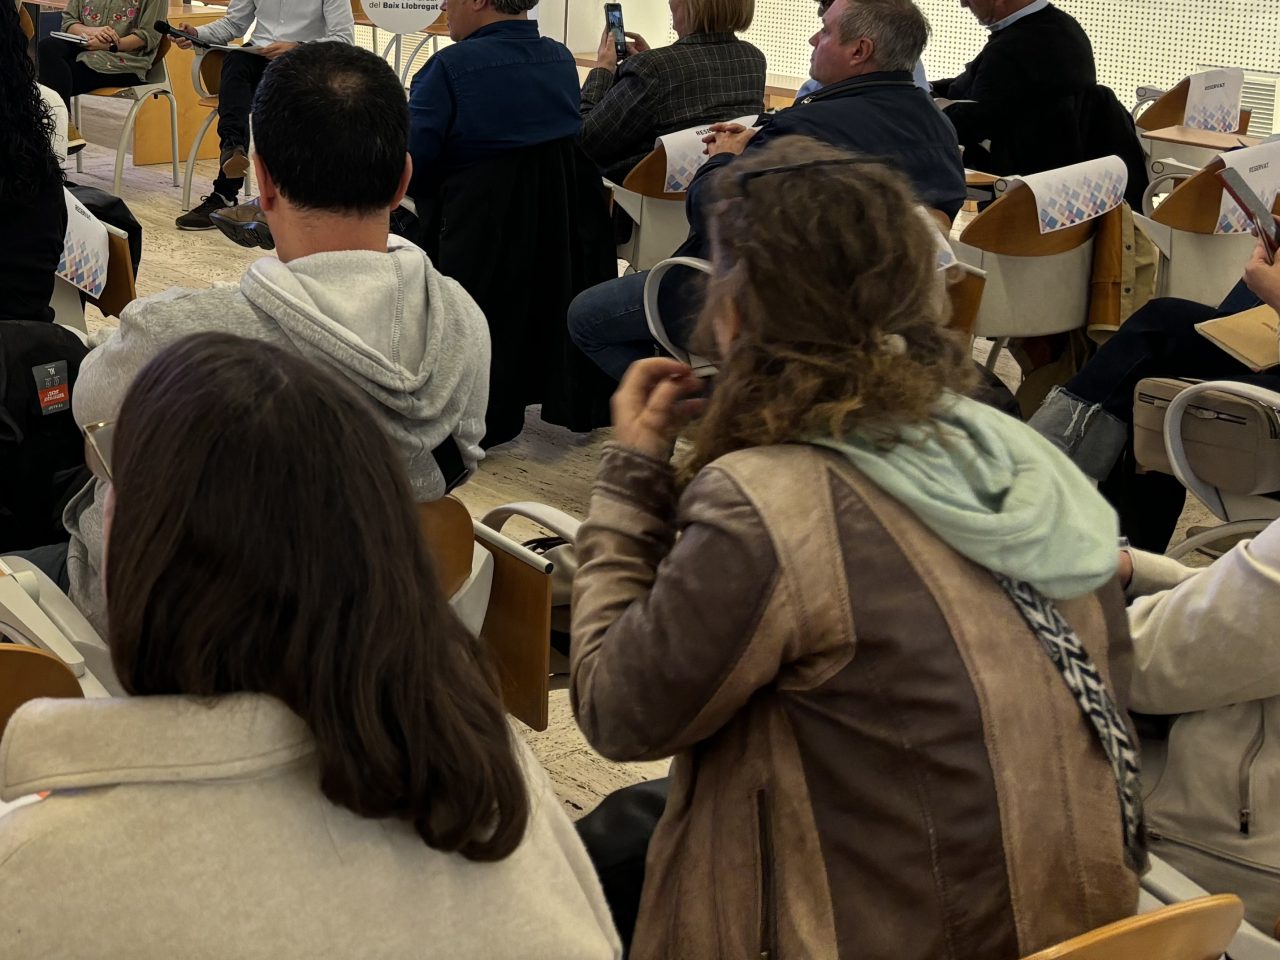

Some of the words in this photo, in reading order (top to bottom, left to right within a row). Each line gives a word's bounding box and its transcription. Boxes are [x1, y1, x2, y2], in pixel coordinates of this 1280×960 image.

[368, 1, 381, 9] del
[383, 1, 400, 9] Baix
[401, 2, 439, 12] Llobregat
[1204, 82, 1226, 91] RESERVAT
[695, 128, 714, 136] RESE
[1248, 161, 1270, 173] RESERVAT
